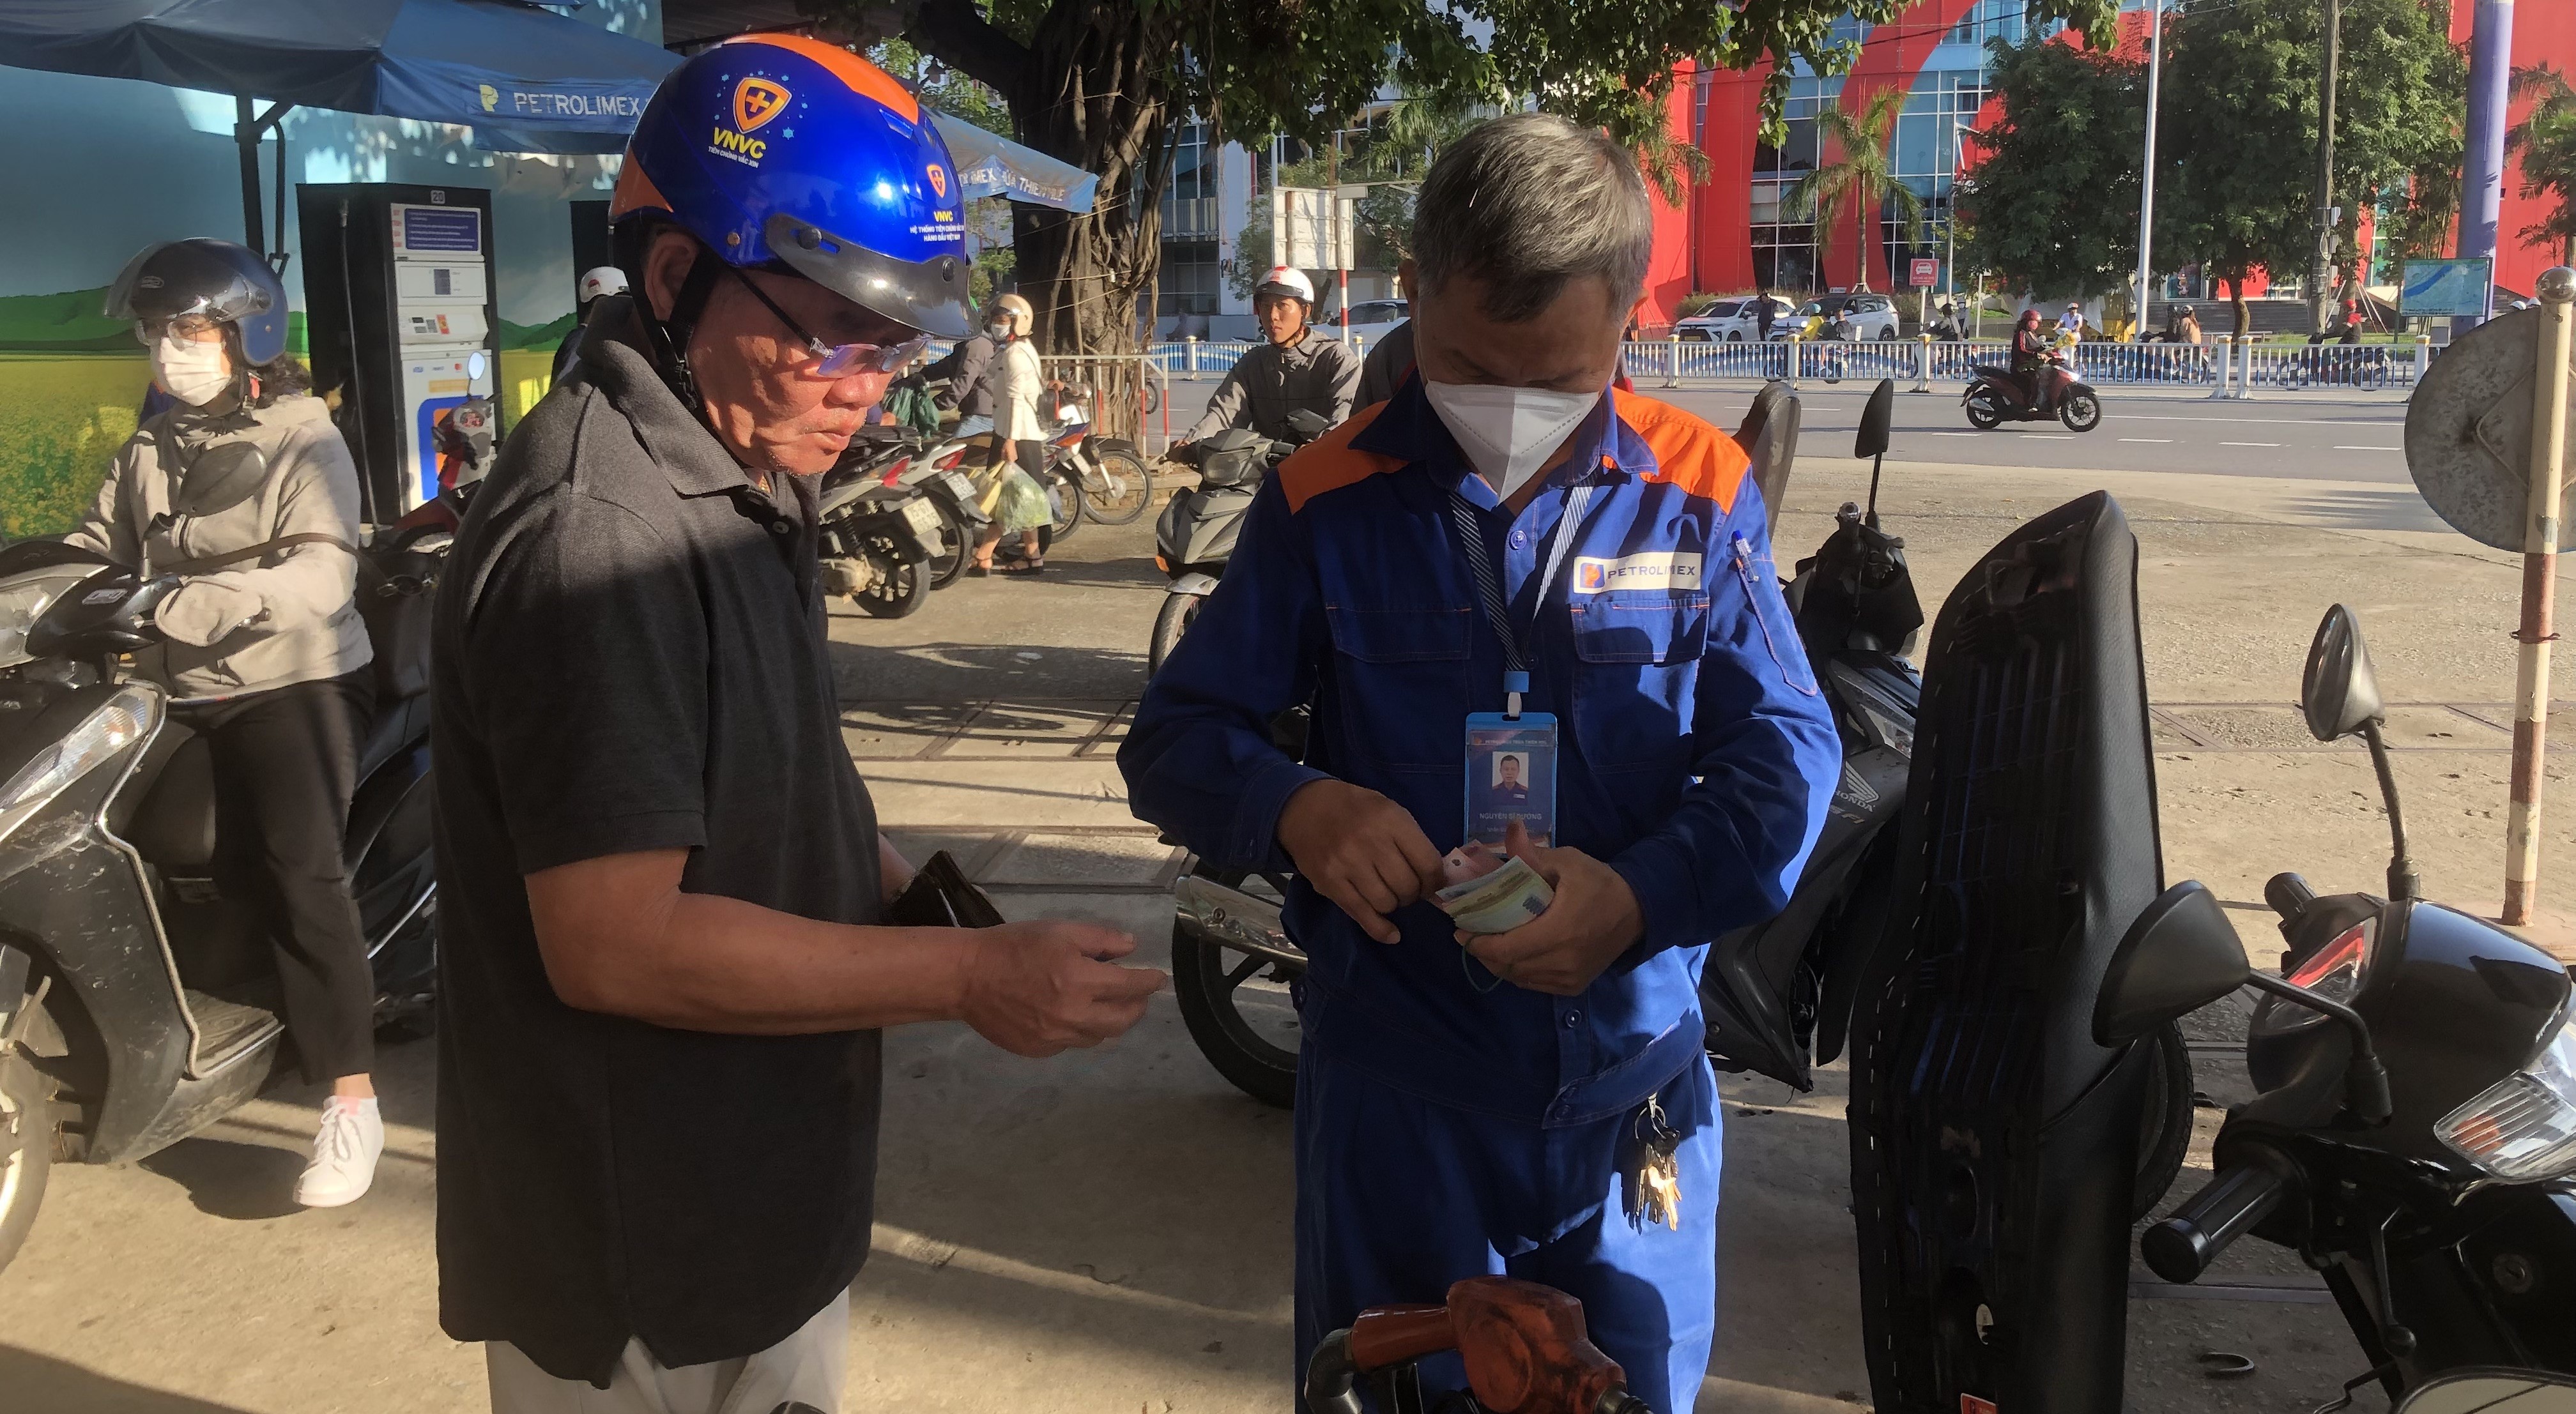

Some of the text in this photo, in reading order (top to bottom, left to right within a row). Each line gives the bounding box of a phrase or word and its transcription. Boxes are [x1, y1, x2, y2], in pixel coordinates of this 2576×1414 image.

[514, 92, 640, 116] PETROLIMEX
[714, 126, 767, 159] VNVC
[933, 210, 953, 222] VNVC
[1607, 565, 1696, 579] PETROLIMEX
